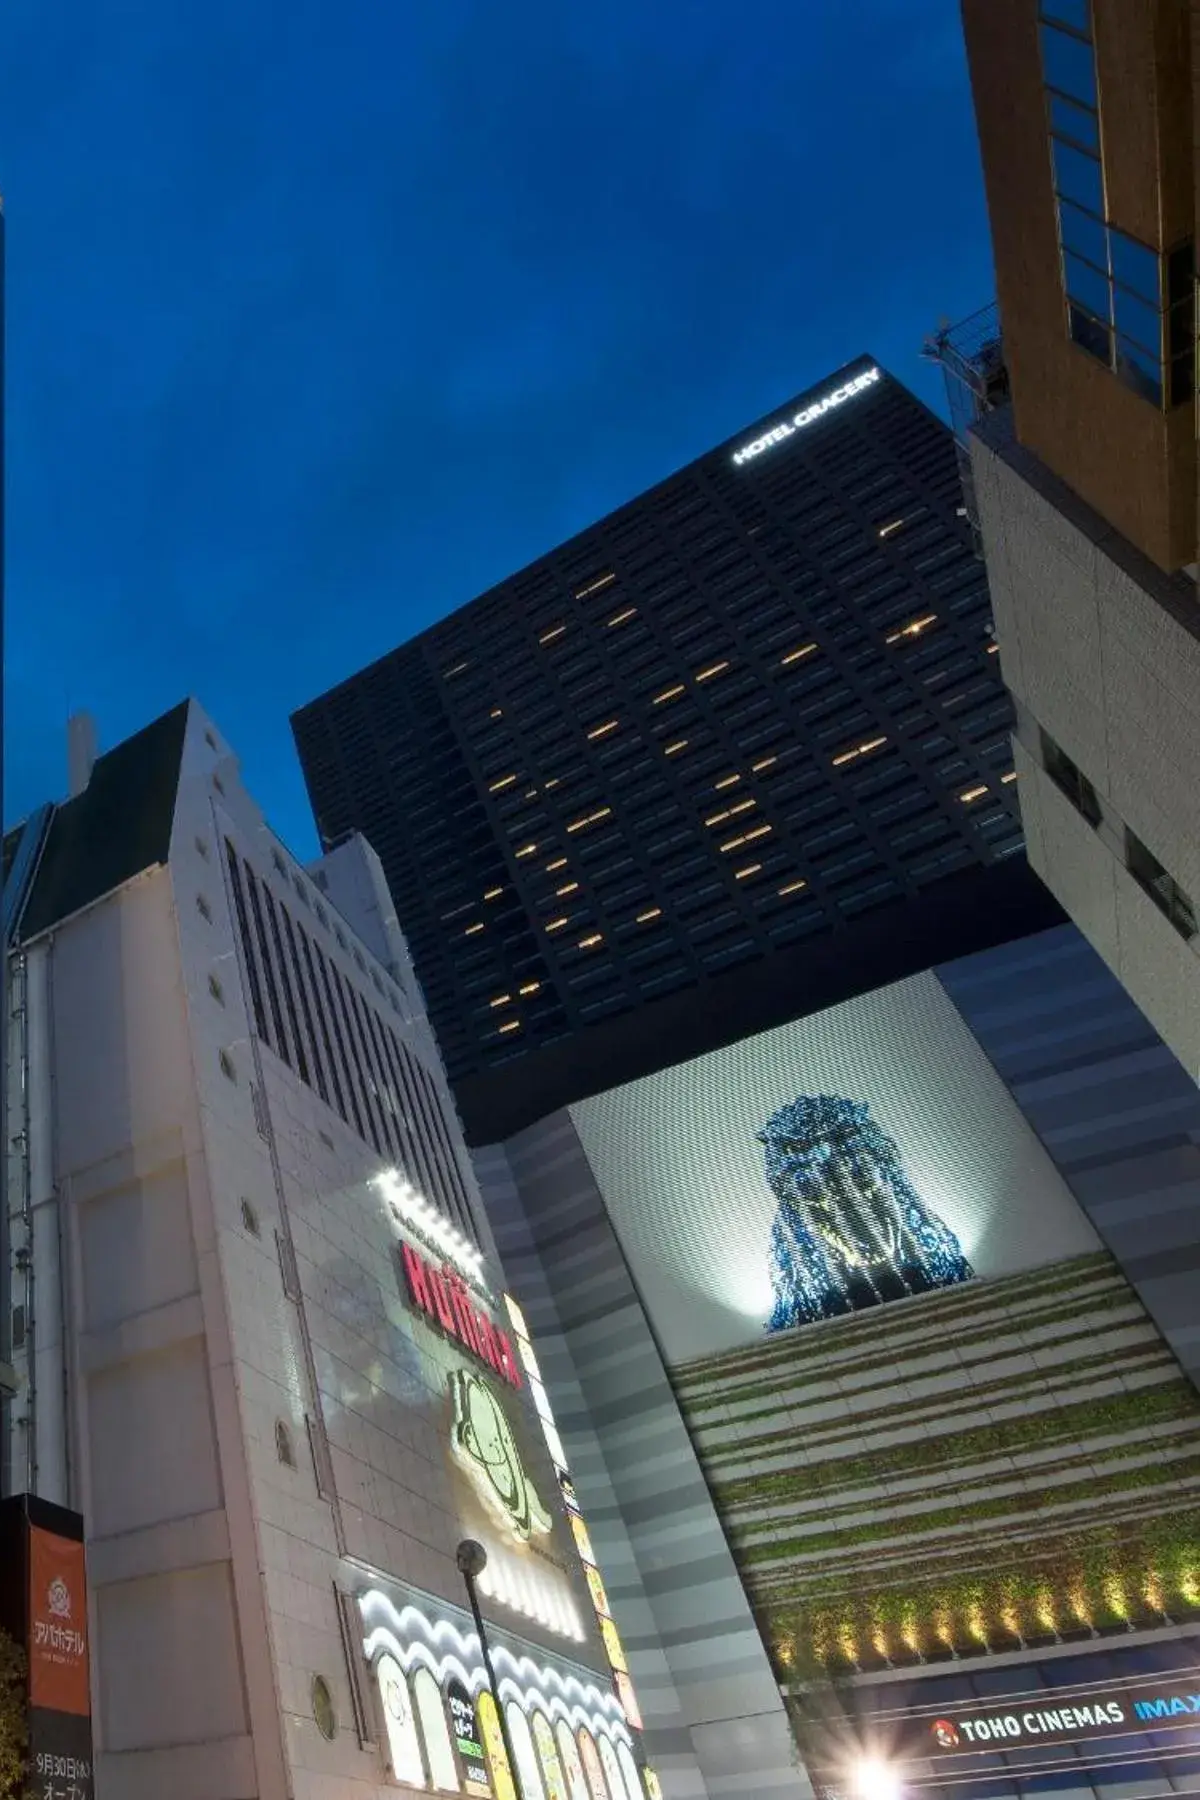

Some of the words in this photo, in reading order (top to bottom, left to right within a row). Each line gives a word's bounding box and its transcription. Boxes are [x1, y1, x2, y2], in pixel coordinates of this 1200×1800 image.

[733, 422, 795, 465] HOTEL
[959, 1715, 1022, 1742] TOHO
[1022, 1701, 1125, 1734] CINEMAS
